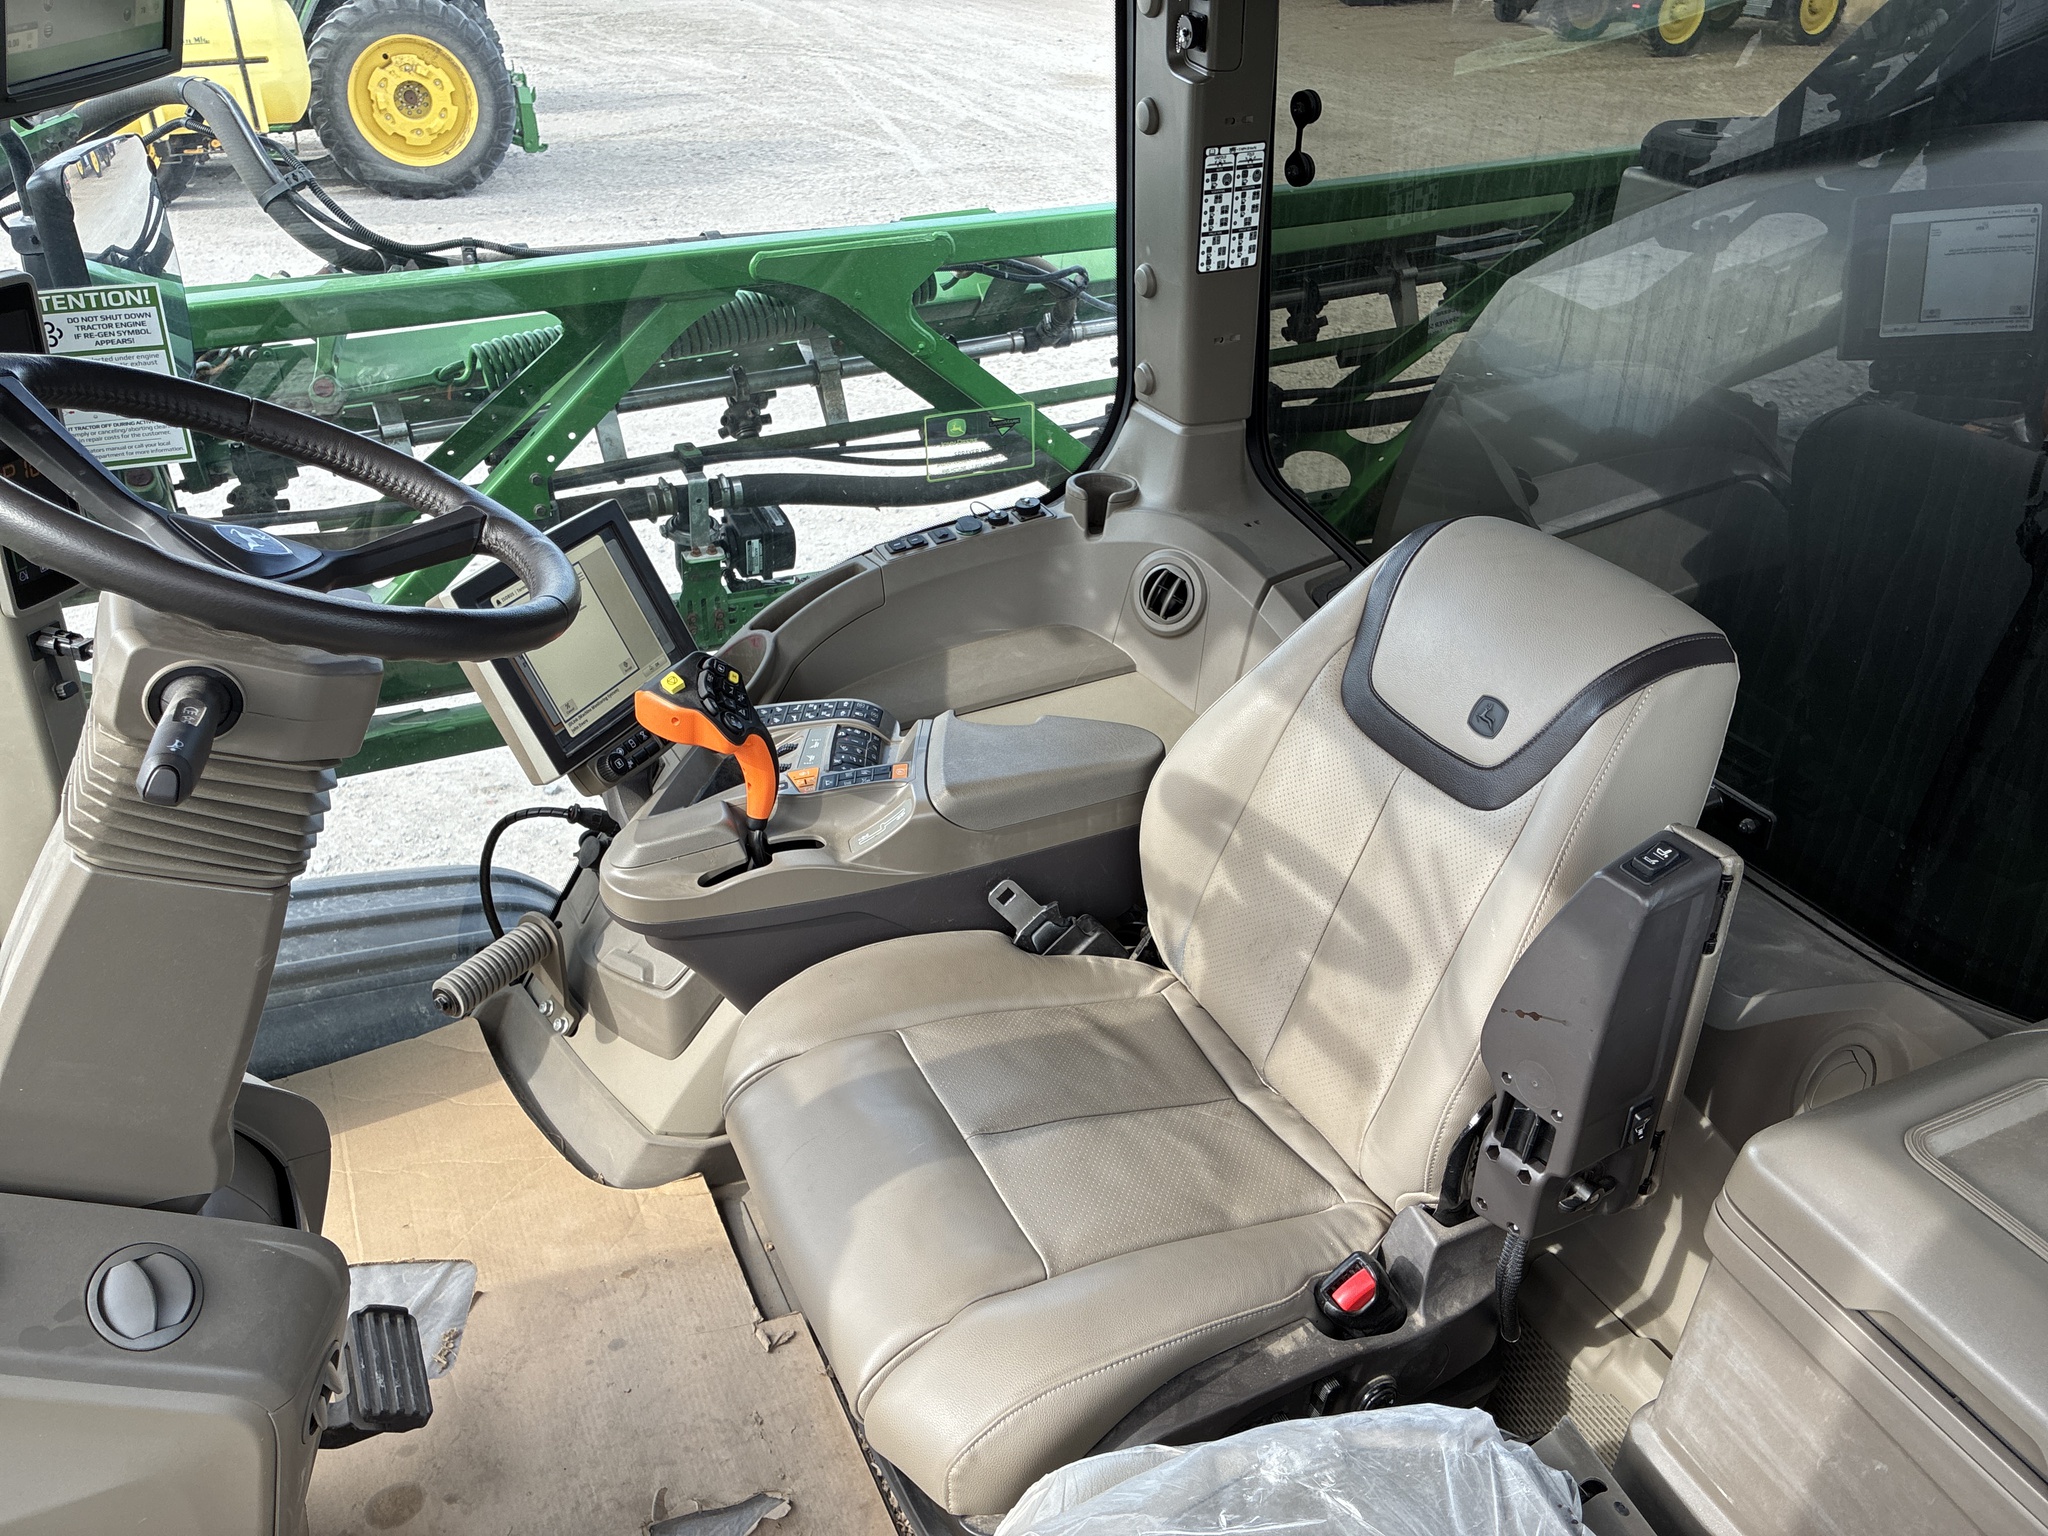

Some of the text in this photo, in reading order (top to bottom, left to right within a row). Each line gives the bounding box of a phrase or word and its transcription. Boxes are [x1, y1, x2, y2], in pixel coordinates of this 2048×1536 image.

[38, 289, 151, 312] TENTION!
[75, 323, 114, 331] TRACTOR
[84, 331, 116, 339] RE-GEN
[94, 338, 136, 346] APPEARS!
[98, 426, 153, 435] canceling/aborting
